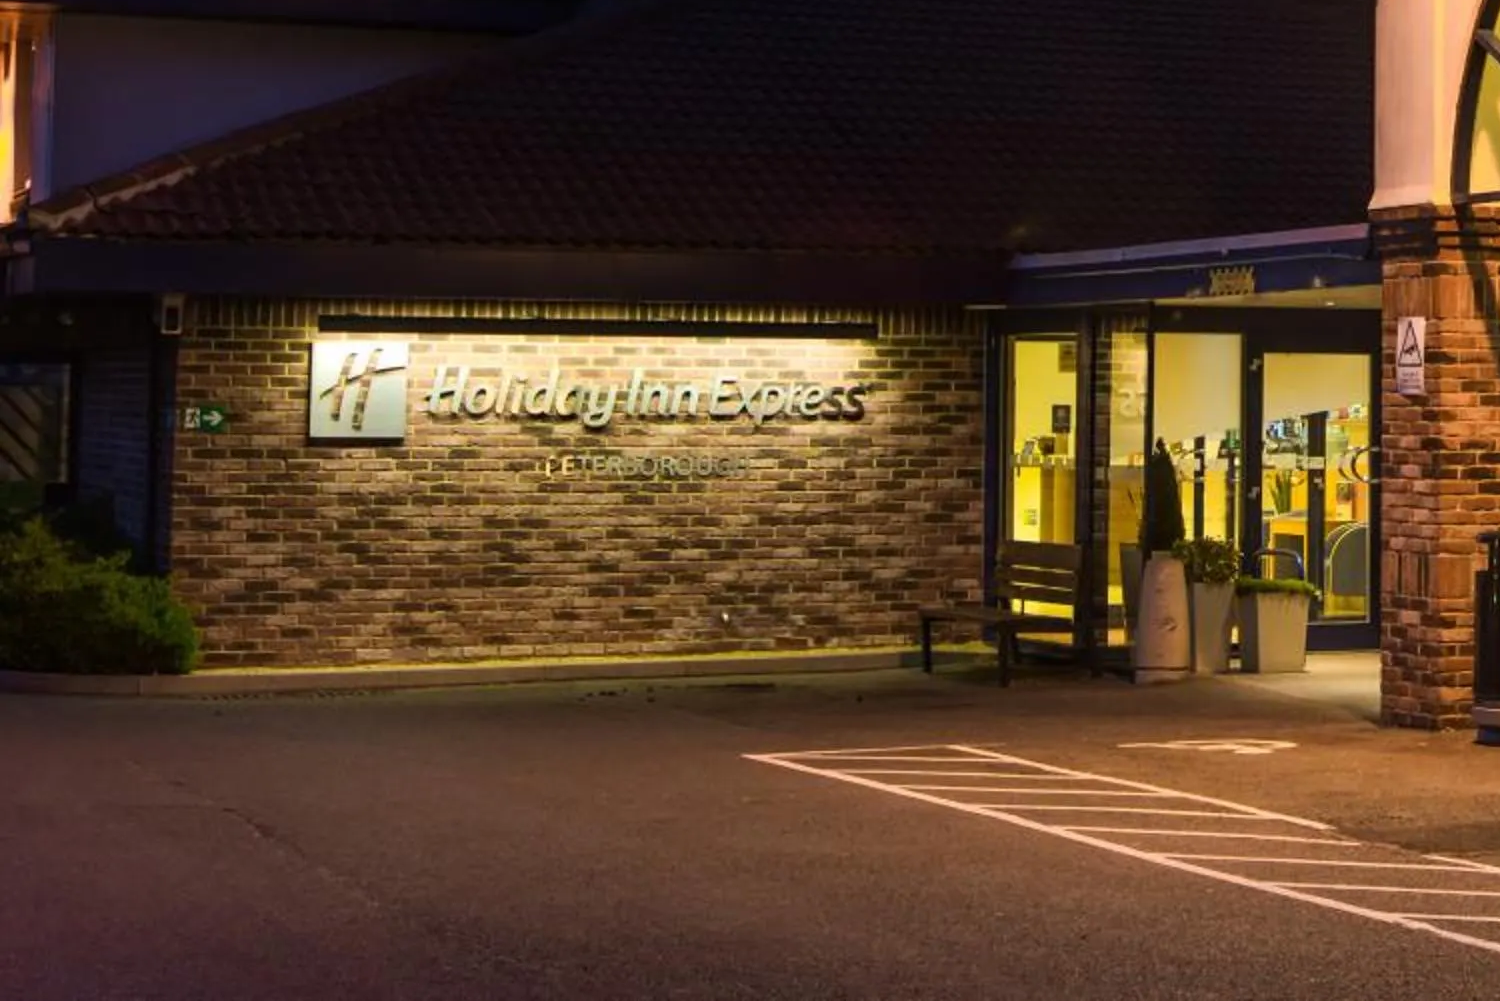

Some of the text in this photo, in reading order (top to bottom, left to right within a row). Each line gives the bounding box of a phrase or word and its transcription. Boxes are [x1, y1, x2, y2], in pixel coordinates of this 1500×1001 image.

[422, 365, 617, 427] Holiday
[625, 366, 700, 417] Inn
[707, 373, 866, 424] Express
[544, 454, 750, 478] PETERBOROUGH
